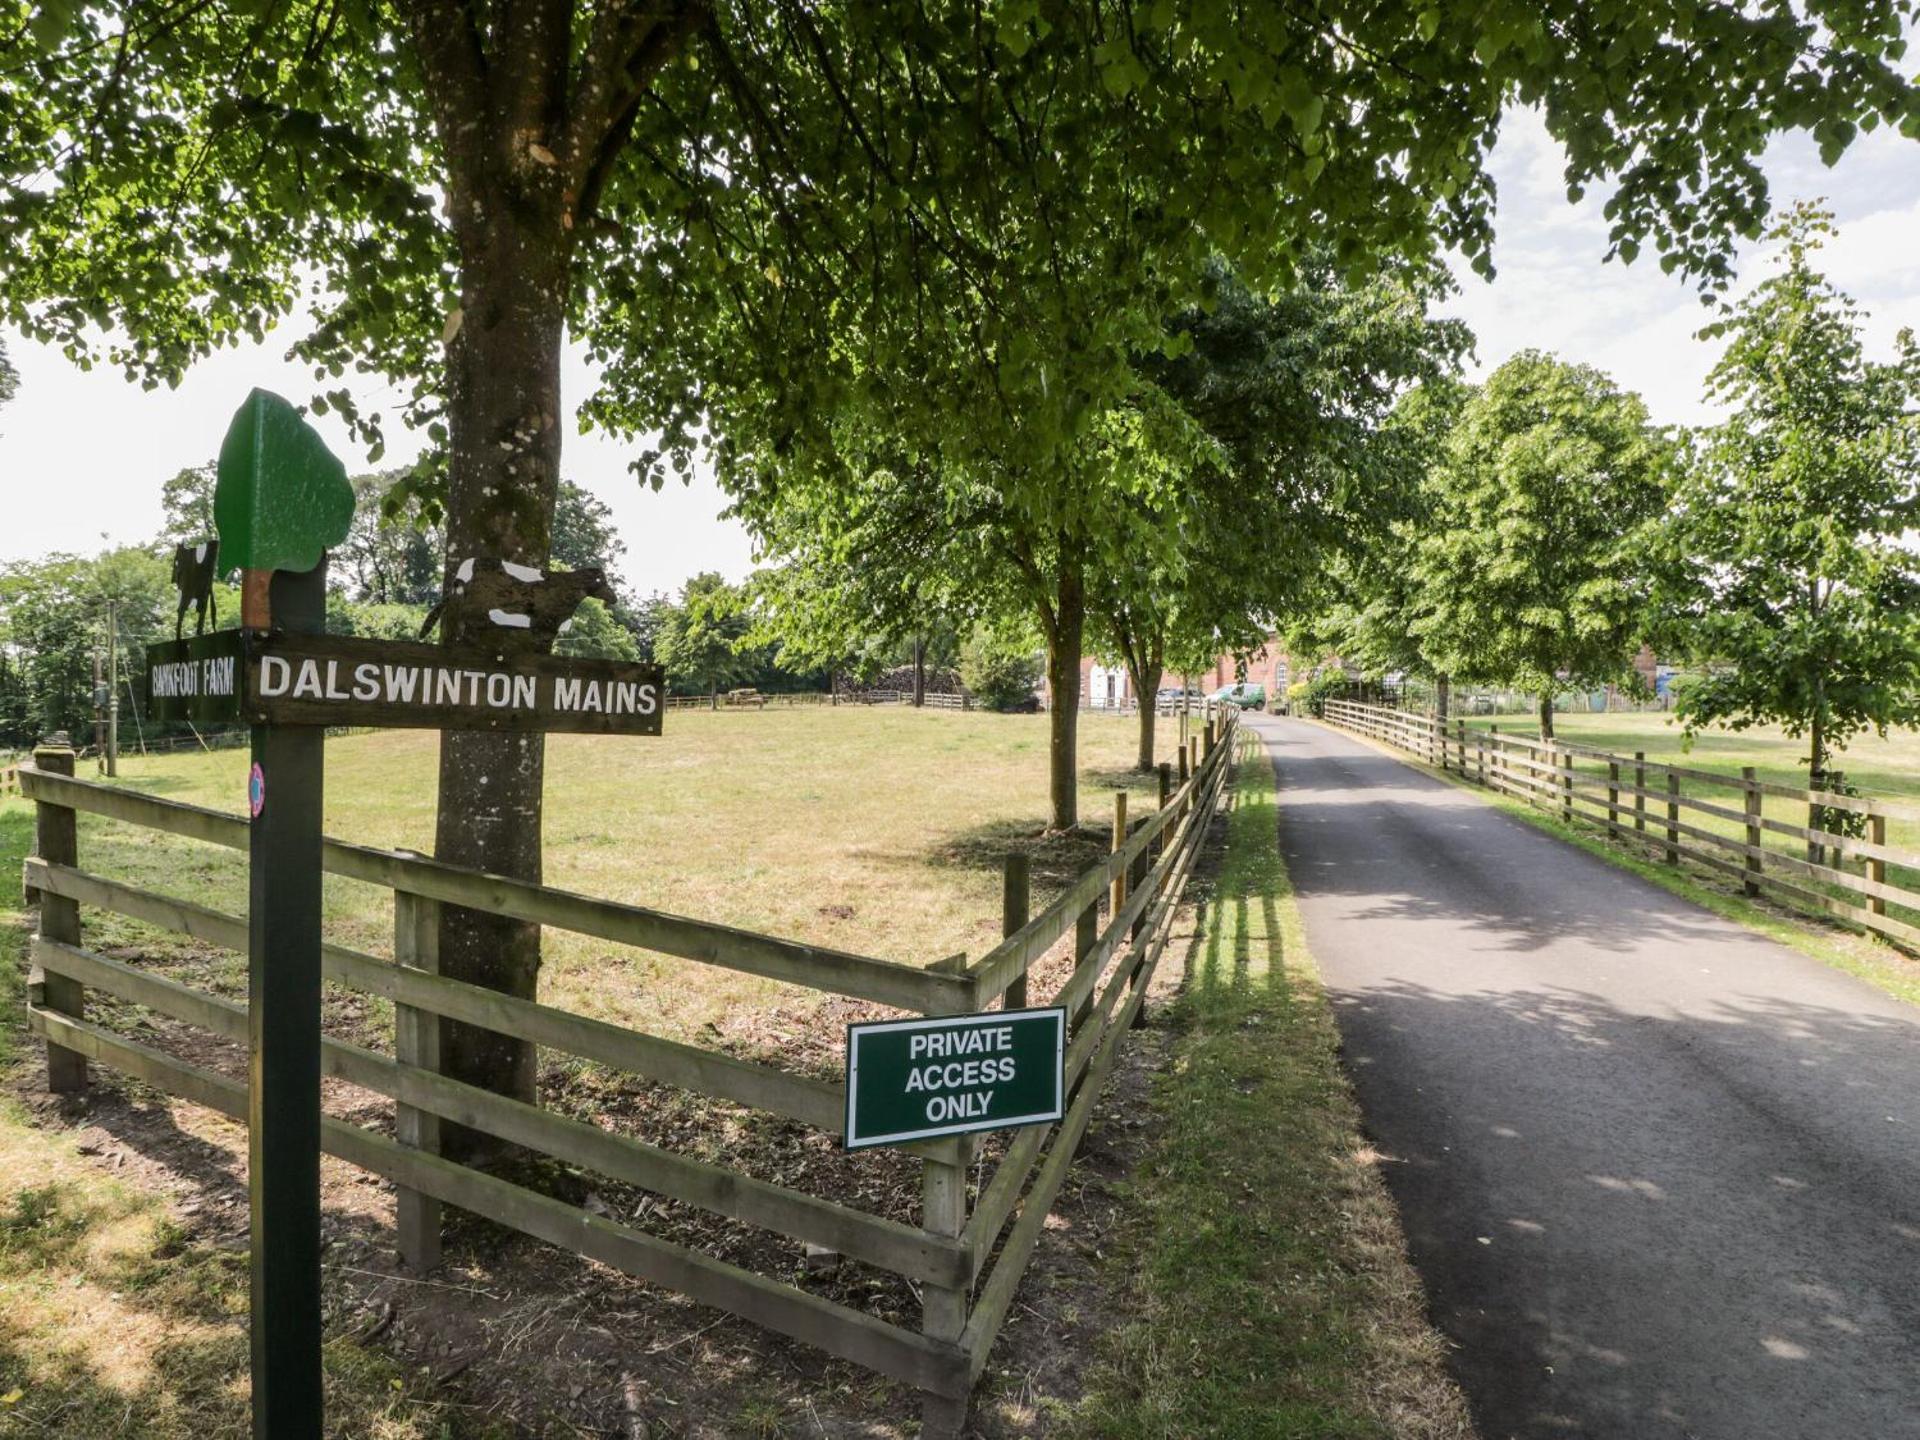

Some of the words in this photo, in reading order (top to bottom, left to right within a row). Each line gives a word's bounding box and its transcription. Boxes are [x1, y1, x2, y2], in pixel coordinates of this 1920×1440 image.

[152, 660, 199, 697] BANKFOOT
[203, 656, 234, 696] FARM
[259, 655, 536, 709] DALSWINTON
[553, 677, 657, 715] MAINS
[910, 1026, 1013, 1060] PRIVATE
[905, 1056, 1016, 1093] ACCESS
[926, 1090, 994, 1122] ONLY
